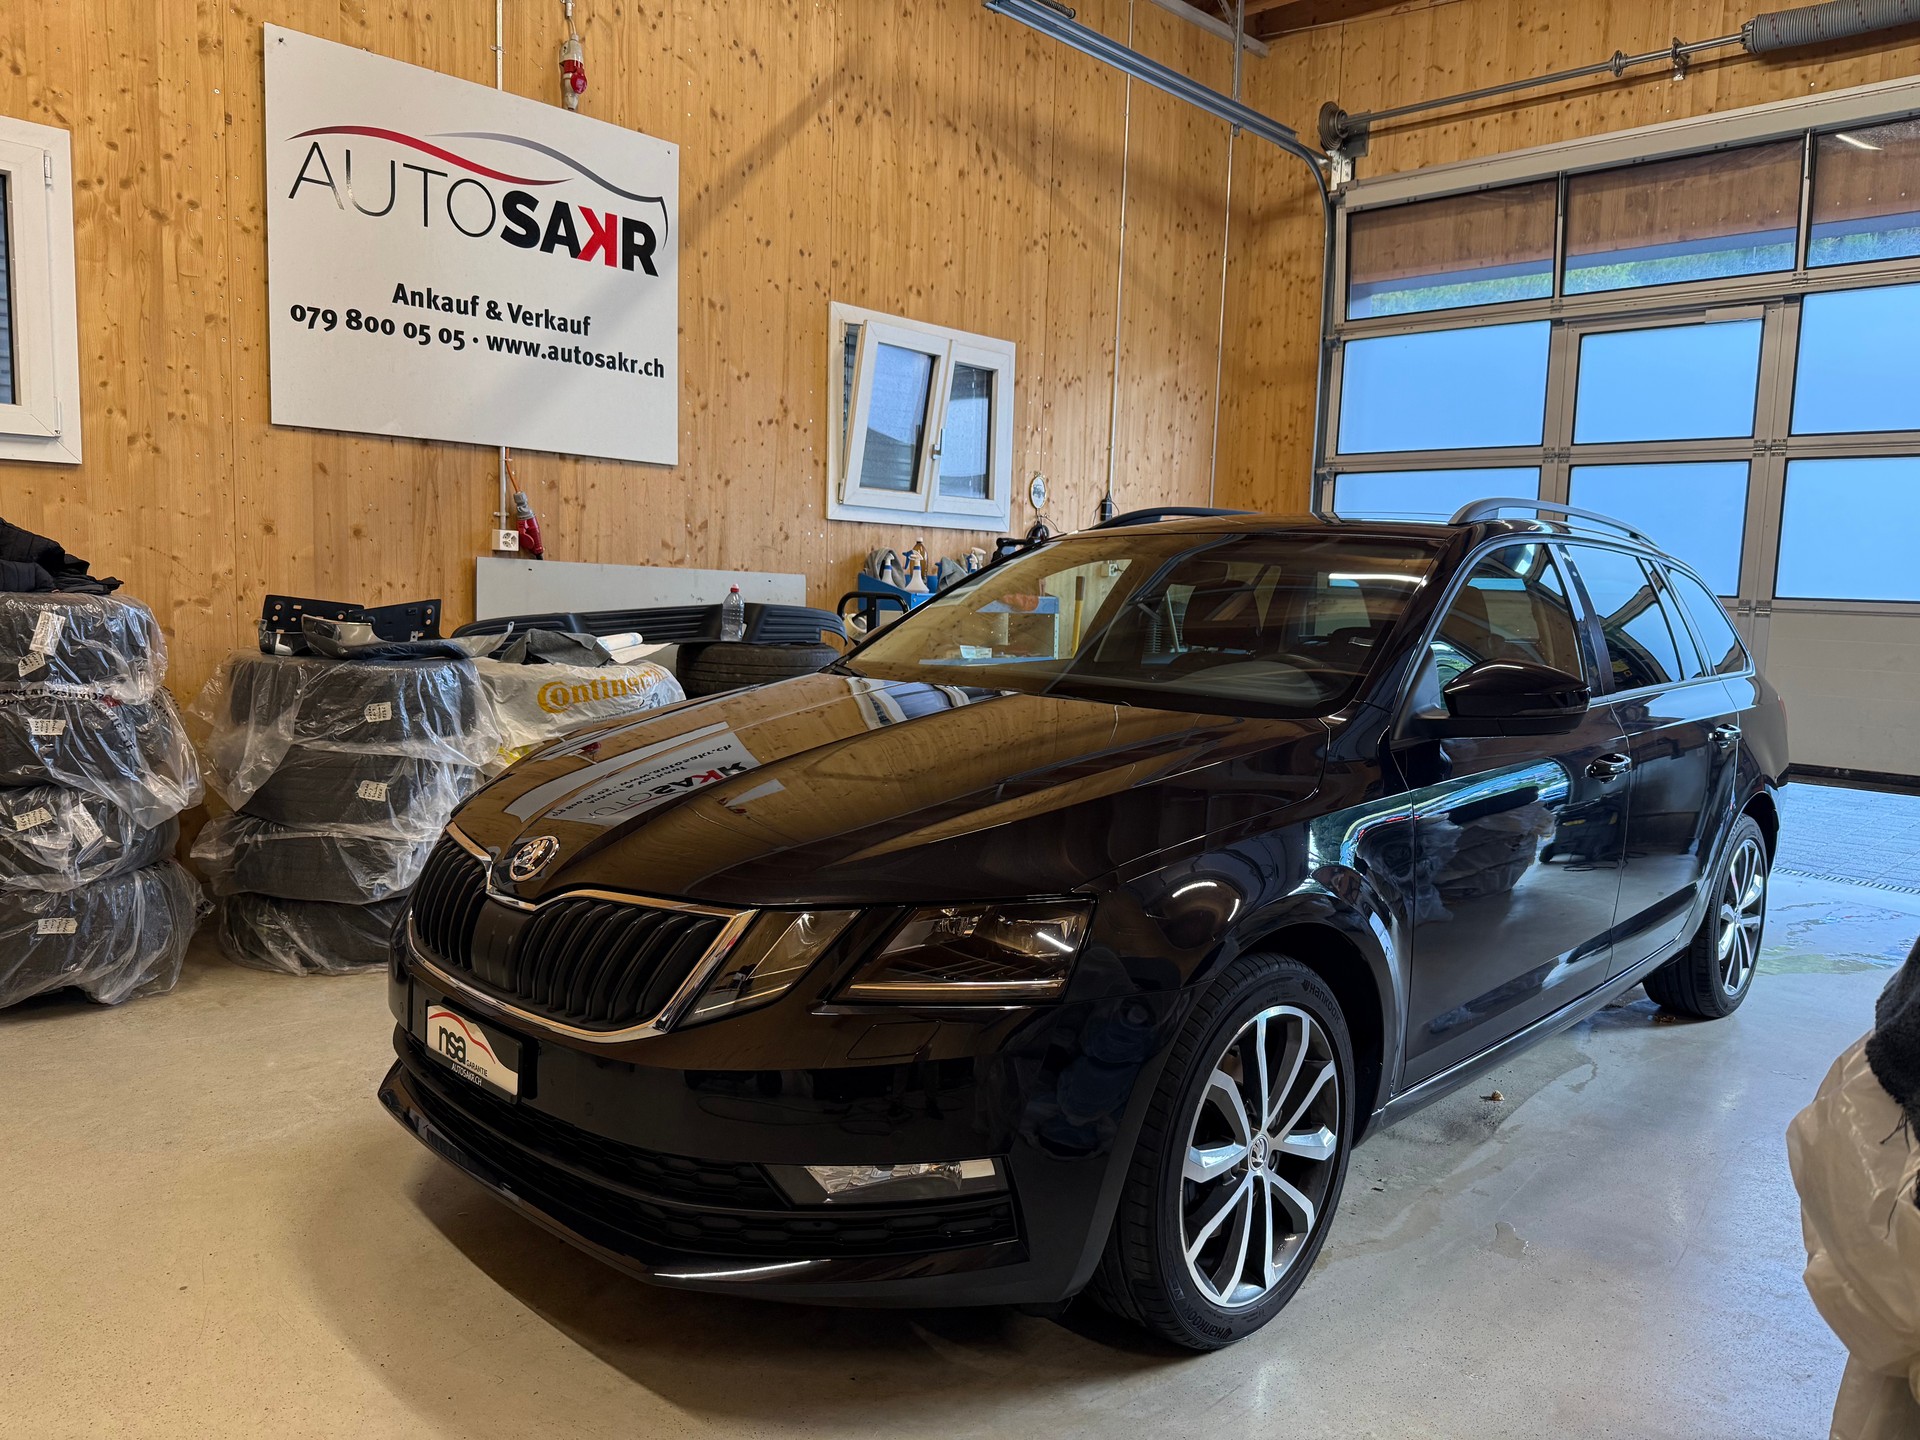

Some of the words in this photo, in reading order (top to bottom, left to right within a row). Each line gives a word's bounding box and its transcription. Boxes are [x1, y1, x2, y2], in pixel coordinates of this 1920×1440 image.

[391, 282, 480, 317] Ankauf
[485, 300, 504, 321] &
[507, 302, 592, 336] Verkauf
[290, 304, 338, 332] 079
[345, 308, 396, 336] 800
[403, 322, 431, 346] 05
[438, 327, 466, 351] 05
[486, 335, 665, 378] www.autosakr.ch
[438, 1025, 467, 1065] nsa
[466, 1058, 488, 1078] GARANTIE
